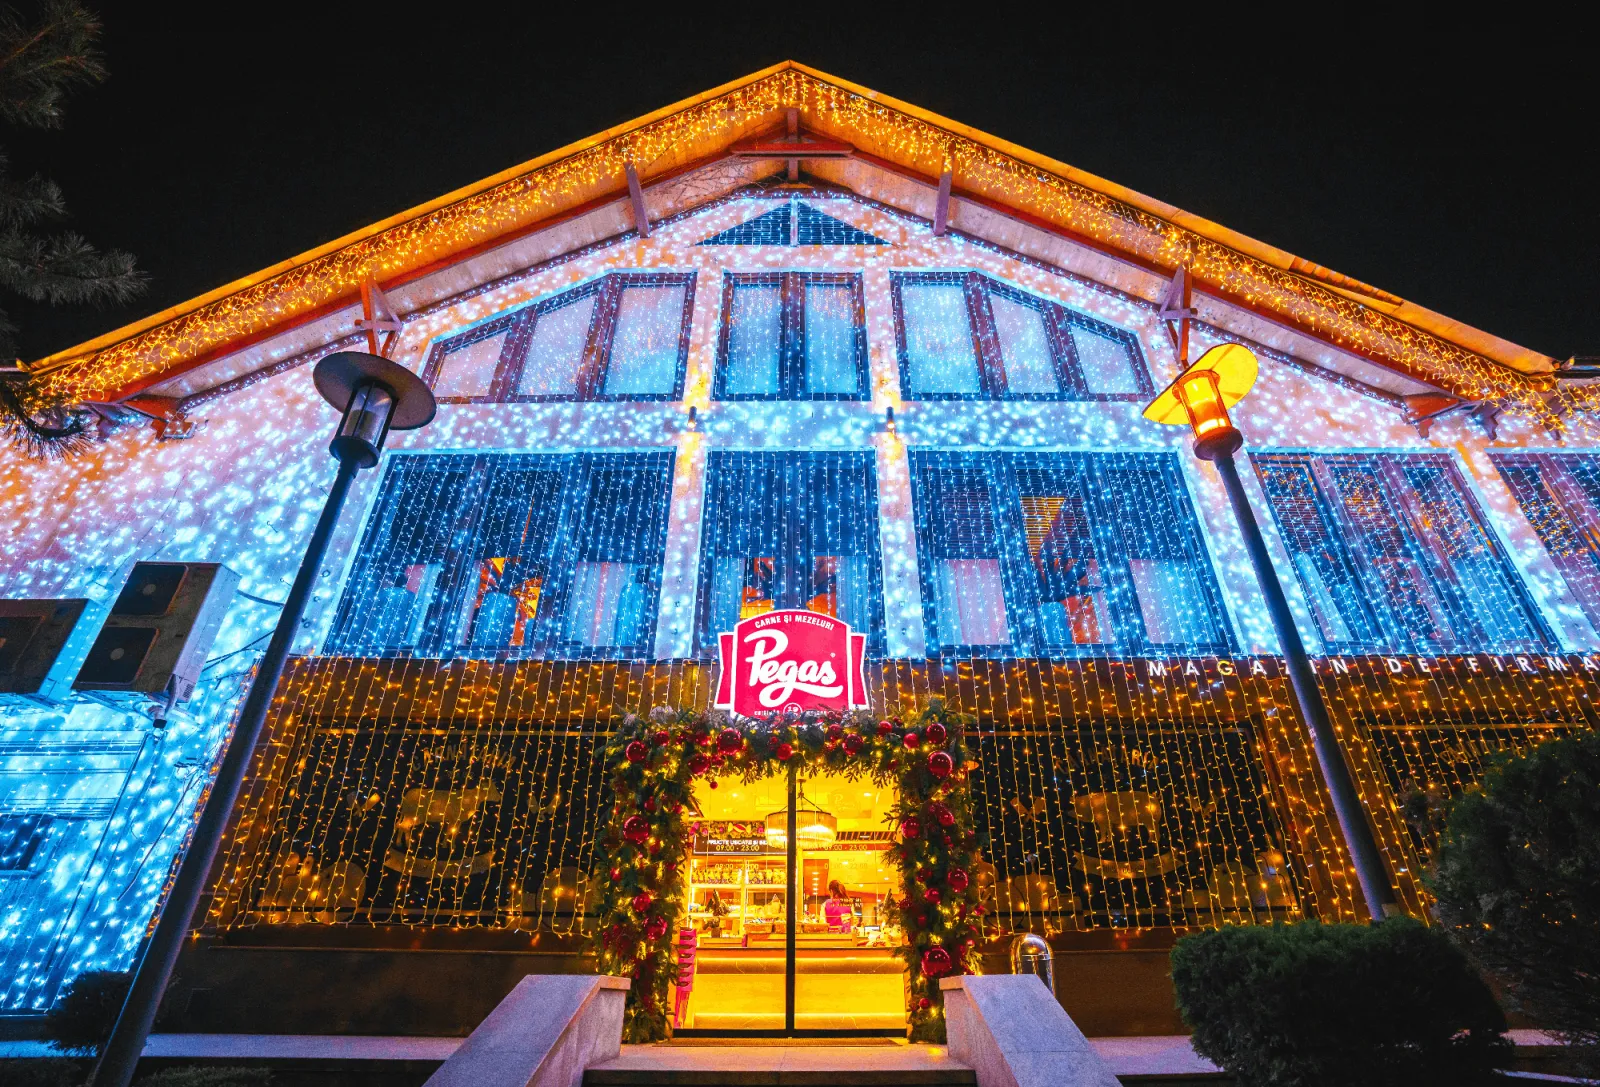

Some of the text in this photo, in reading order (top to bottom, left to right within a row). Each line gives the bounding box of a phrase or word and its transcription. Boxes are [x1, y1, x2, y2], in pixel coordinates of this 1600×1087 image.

[755, 616, 781, 628] CARNE
[795, 615, 835, 631] MEZELURI
[744, 629, 844, 707] Pegas
[1387, 657, 1431, 673] DE
[1466, 656, 1600, 673] FIRMA
